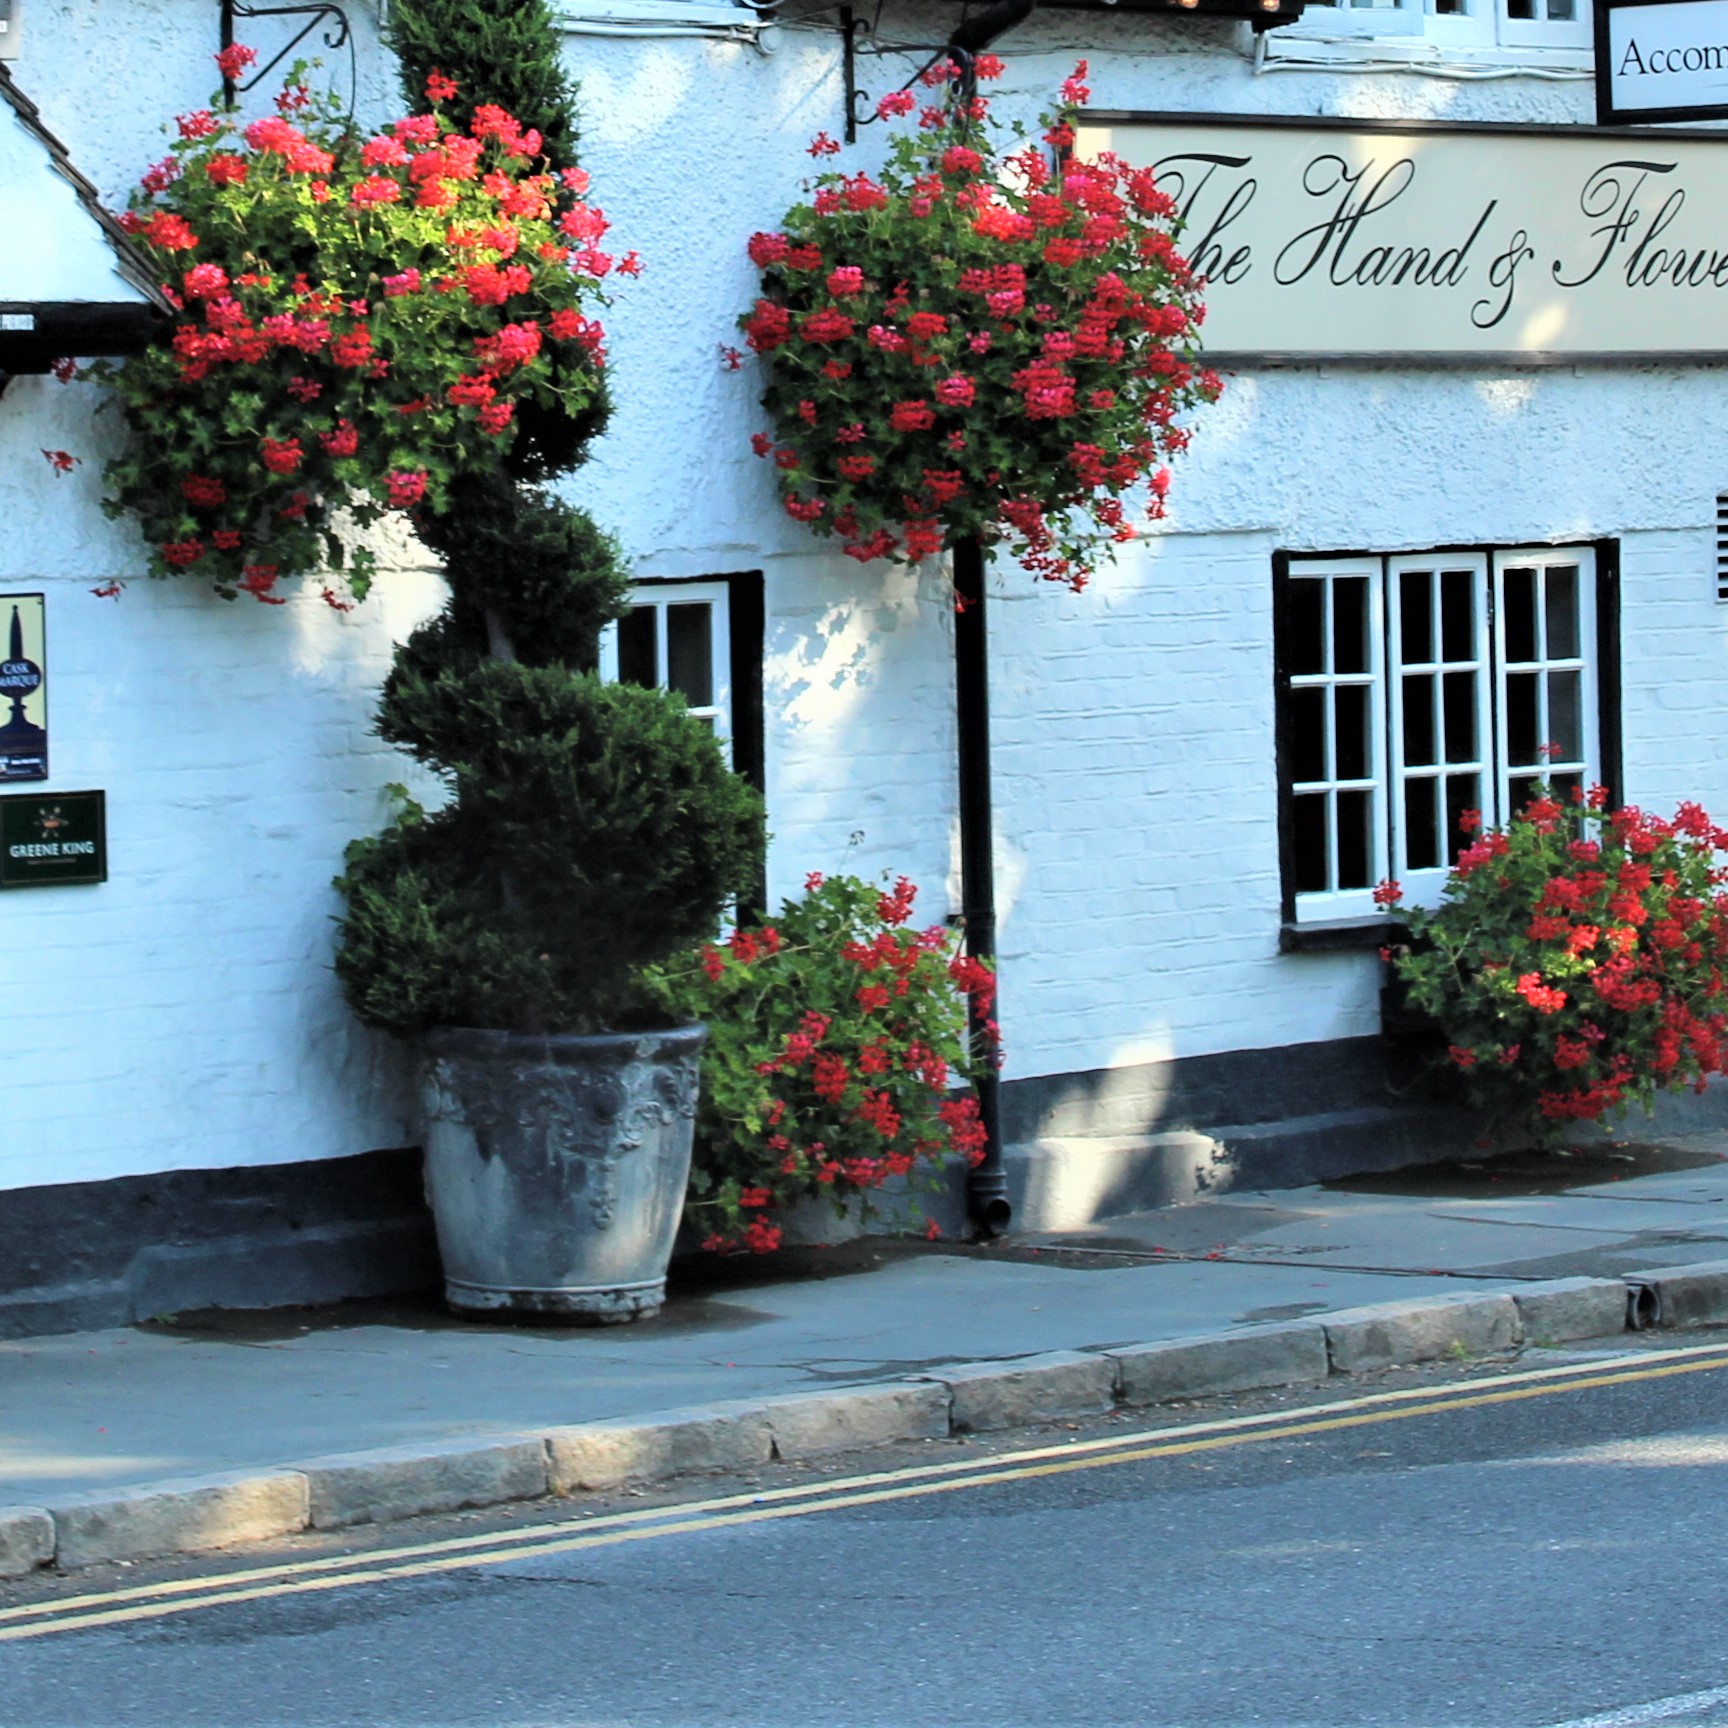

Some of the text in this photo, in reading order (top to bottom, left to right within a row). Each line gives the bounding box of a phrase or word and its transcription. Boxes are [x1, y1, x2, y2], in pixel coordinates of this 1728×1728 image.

[1274, 154, 1498, 287] Hand
[1471, 229, 1534, 329] &
[3, 663, 30, 674] CASK
[9, 840, 95, 858] GREENE KING
